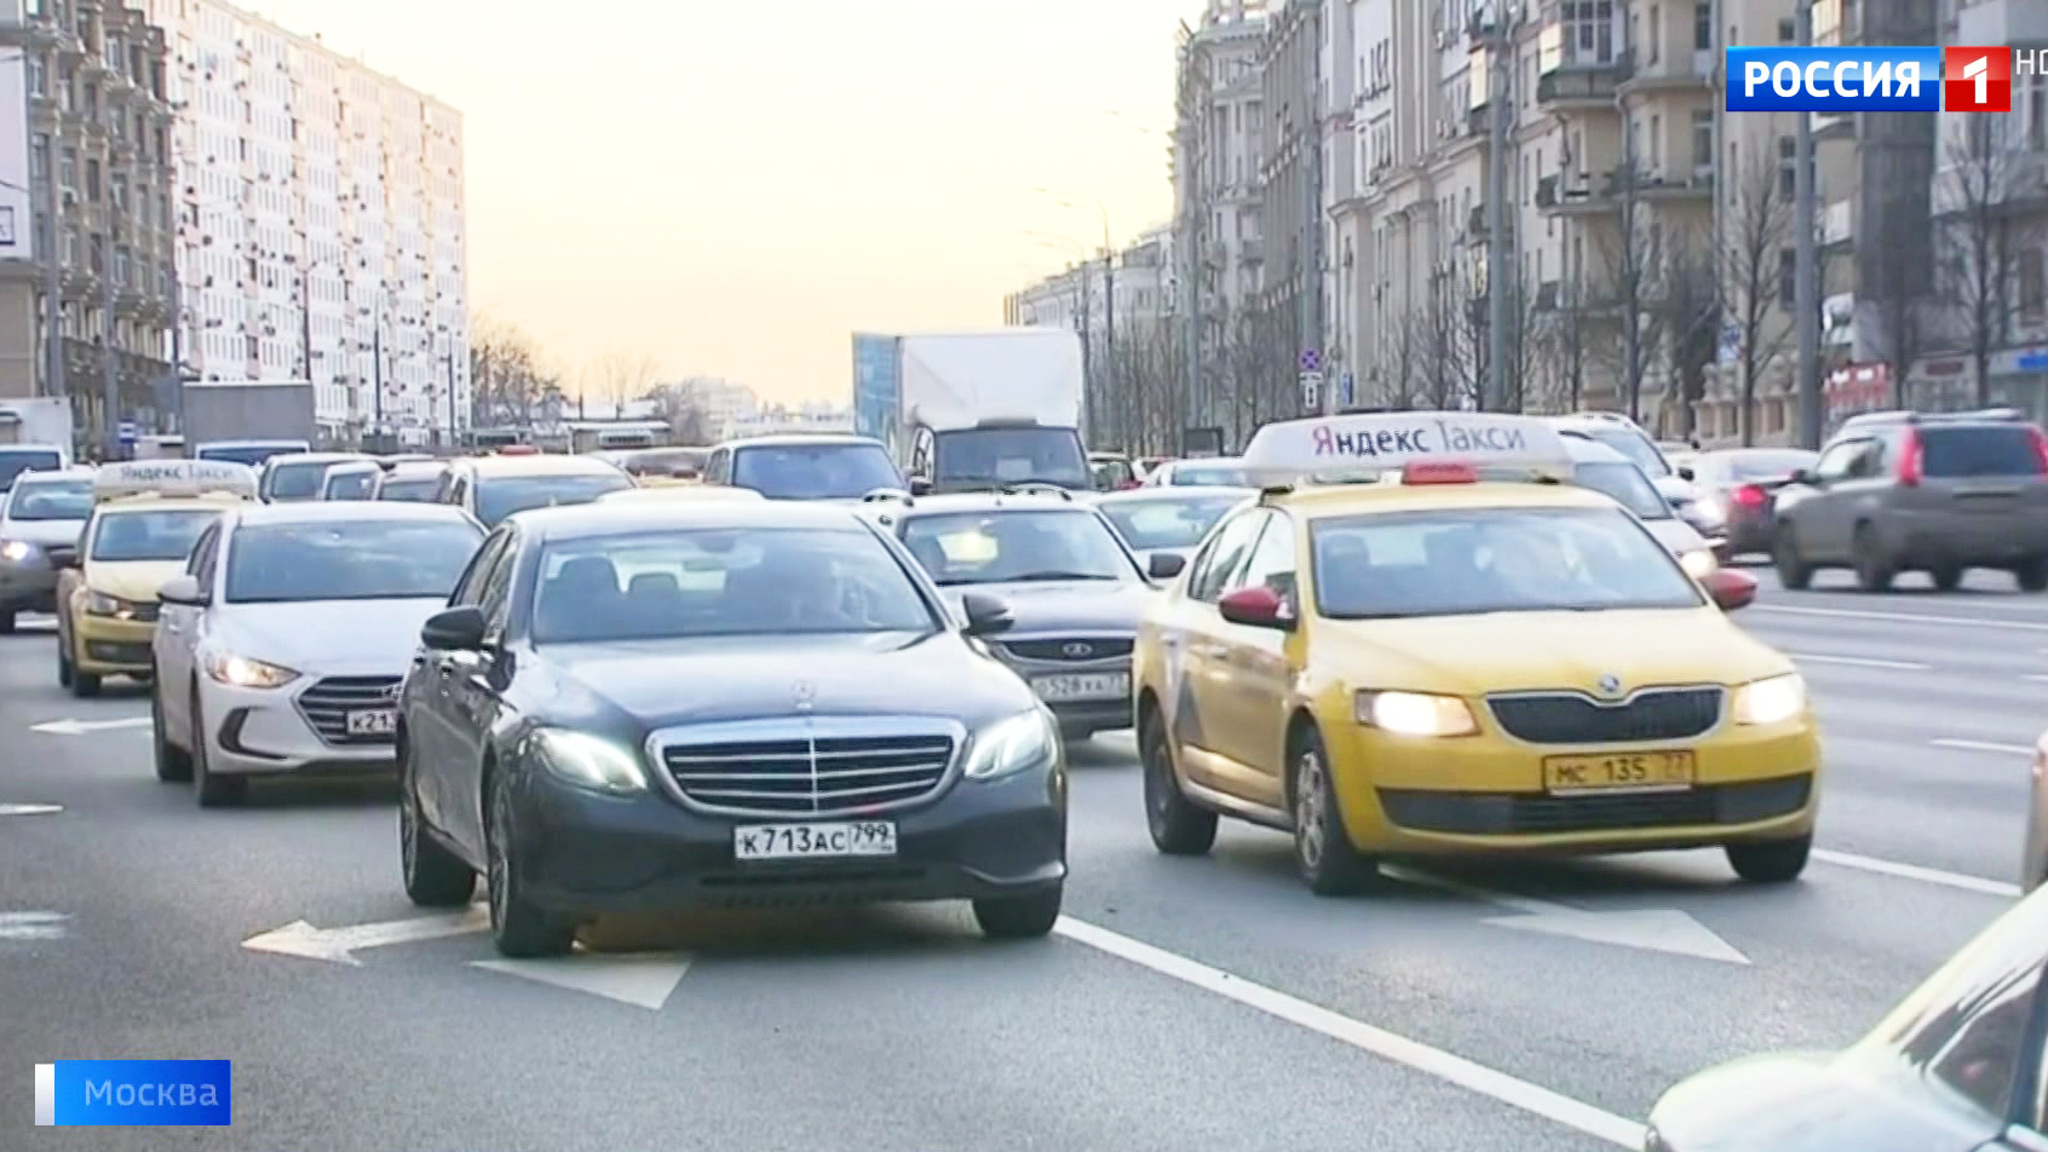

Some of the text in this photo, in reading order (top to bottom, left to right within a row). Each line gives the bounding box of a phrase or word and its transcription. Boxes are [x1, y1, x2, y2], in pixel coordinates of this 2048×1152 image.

[1312, 419, 1526, 458] Яндекс Такси
[121, 463, 181, 481] Яндекс
[1604, 756, 1647, 781] 135
[854, 822, 889, 843] 799
